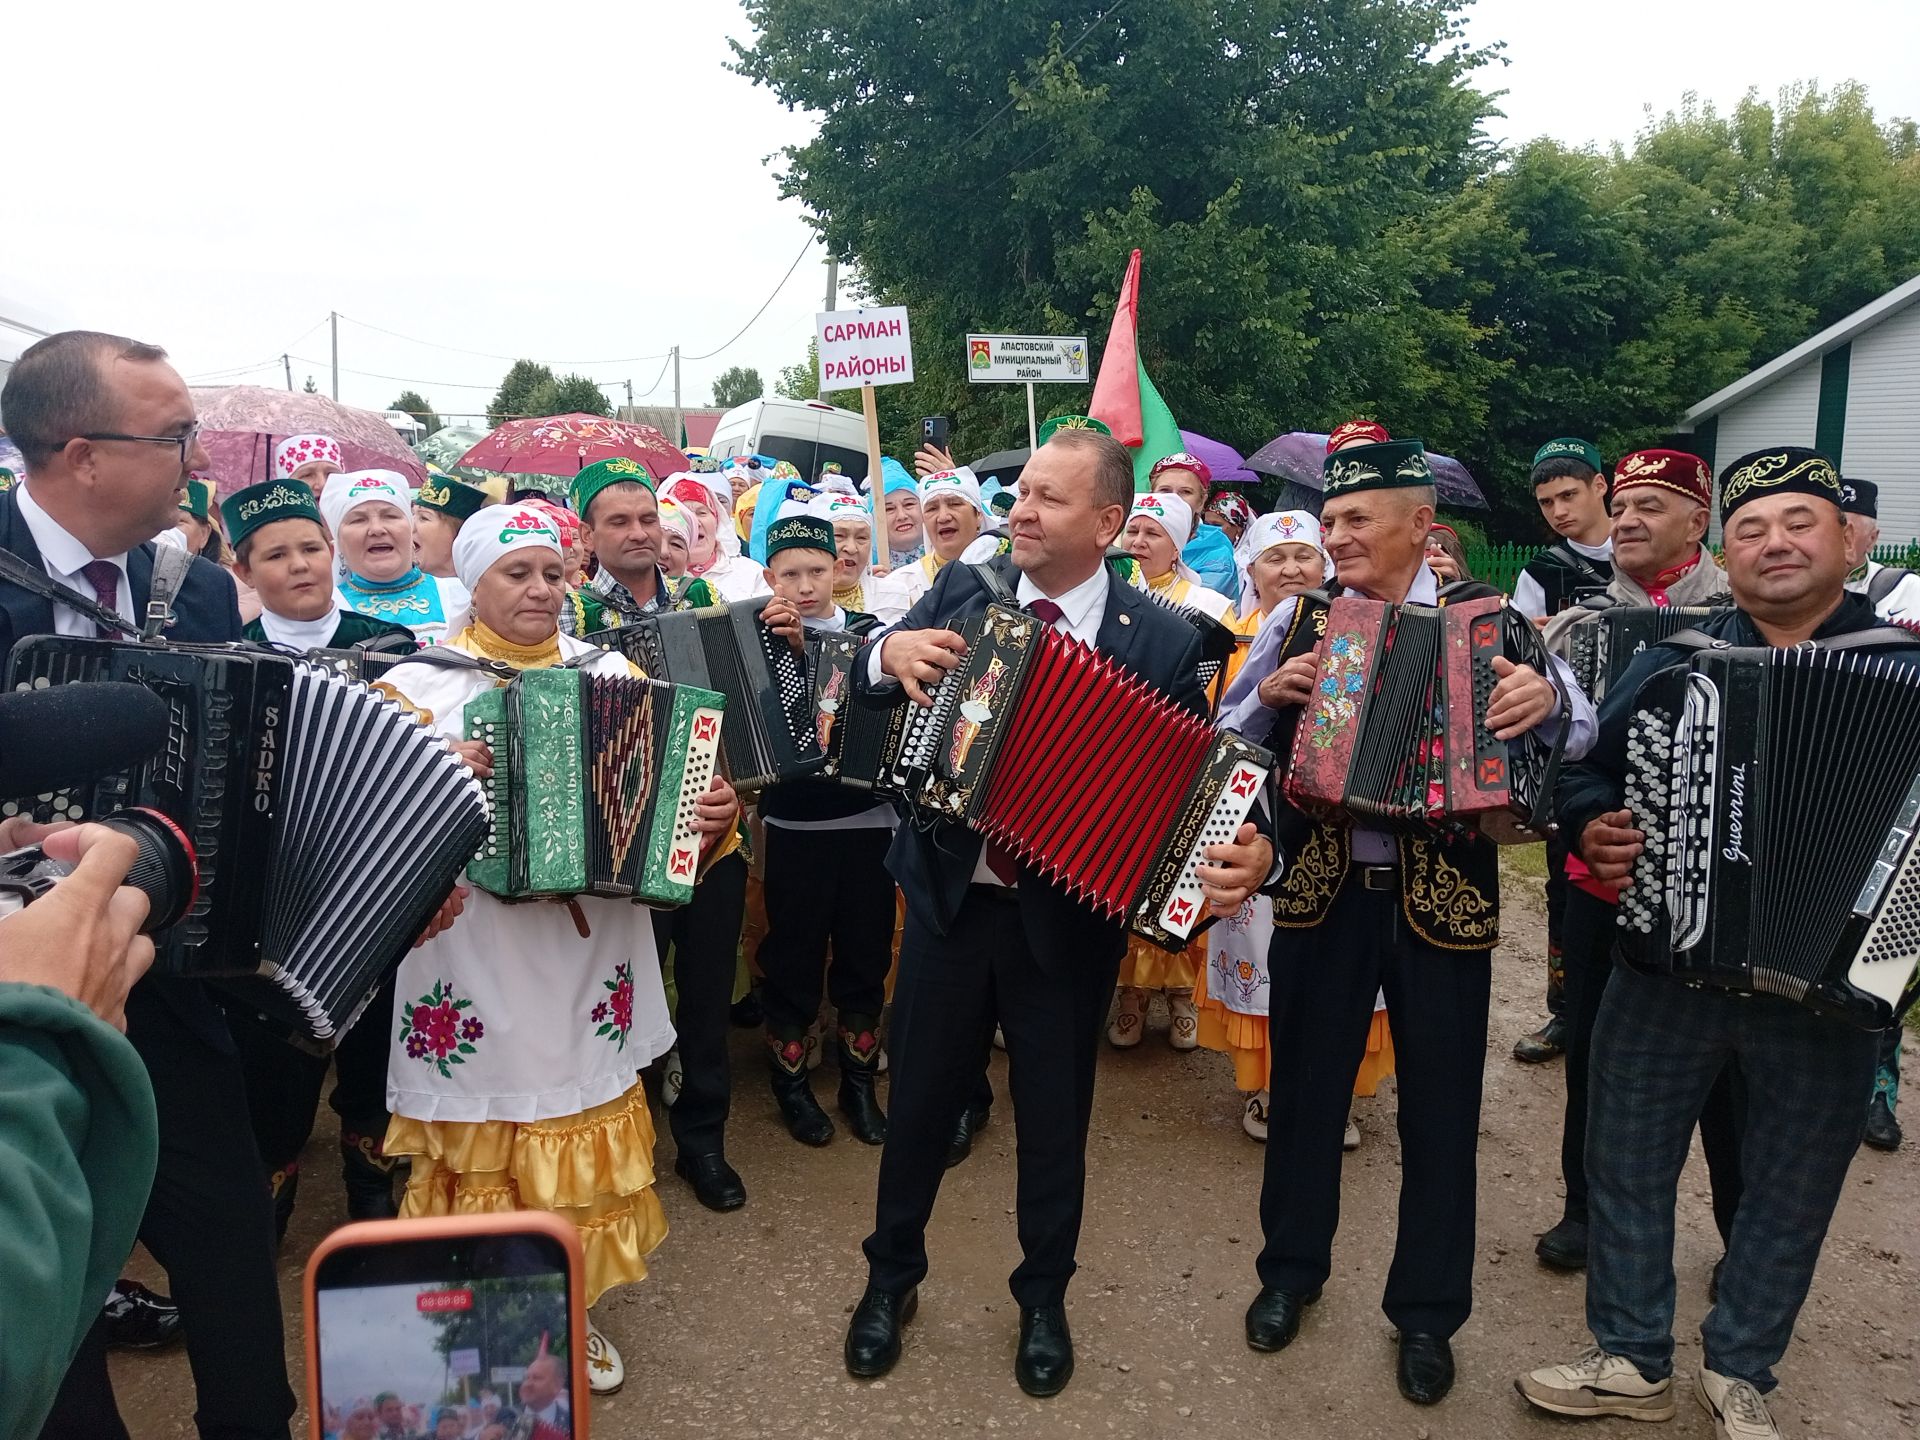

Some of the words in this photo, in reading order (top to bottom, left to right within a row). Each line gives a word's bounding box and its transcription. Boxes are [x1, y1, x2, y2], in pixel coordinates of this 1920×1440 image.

[824, 319, 901, 342] САРМАН
[1000, 341, 1054, 351] АПАСТОВСКИЙ
[825, 355, 905, 380] РАЙОНЫ
[994, 354, 1061, 366] МУНИЦИПАЛЬНЫЙ
[1016, 367, 1042, 378] РАЙОН
[254, 706, 279, 812] SADKO
[1151, 862, 1177, 903] ПОЛЕ
